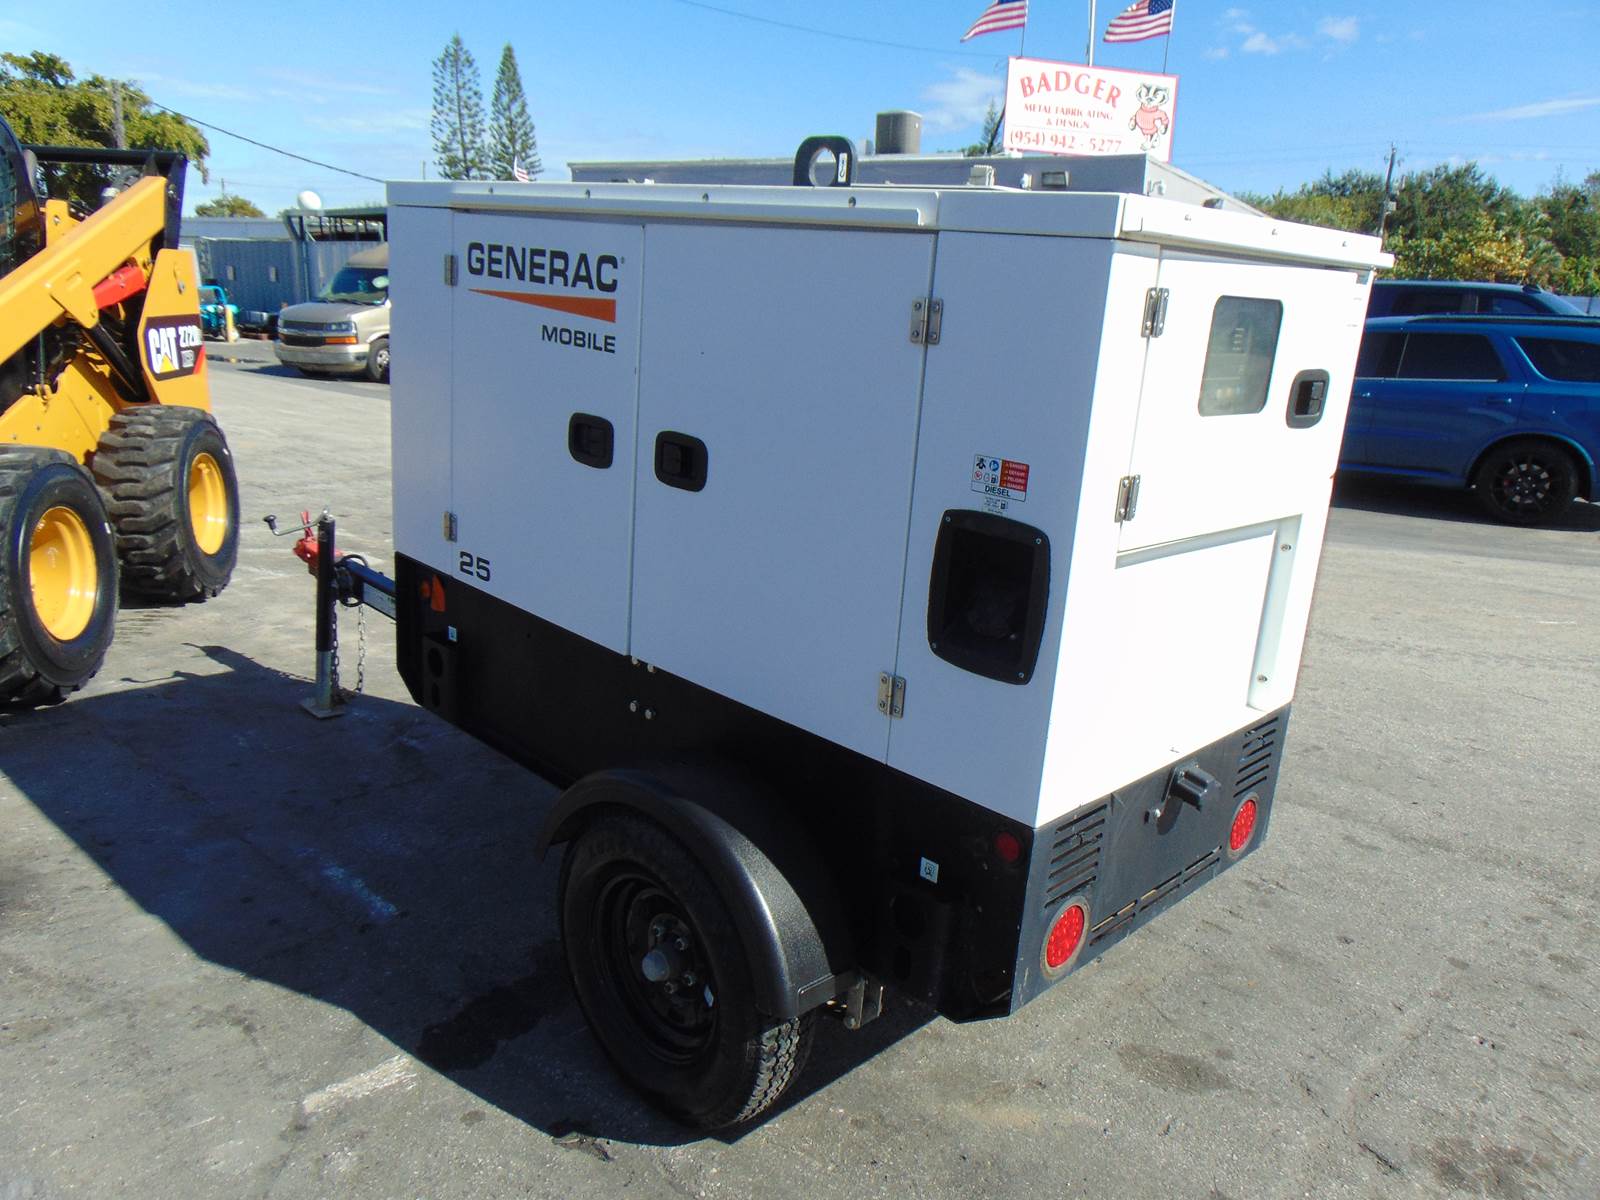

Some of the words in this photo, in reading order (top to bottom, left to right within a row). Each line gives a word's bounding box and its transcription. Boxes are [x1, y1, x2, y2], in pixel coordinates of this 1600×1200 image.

[1020, 71, 1121, 108] BADGER
[1024, 102, 1052, 114] METAL
[1056, 118, 1090, 129] DESIGN
[1010, 127, 1046, 147] (954)
[1050, 132, 1075, 149] 942
[1089, 136, 1122, 153] 5277
[467, 241, 619, 293] GENERAC
[148, 326, 180, 374] CAT
[541, 324, 616, 354] MOBILE
[984, 485, 1010, 497] DIESEL
[460, 550, 491, 582] 25
